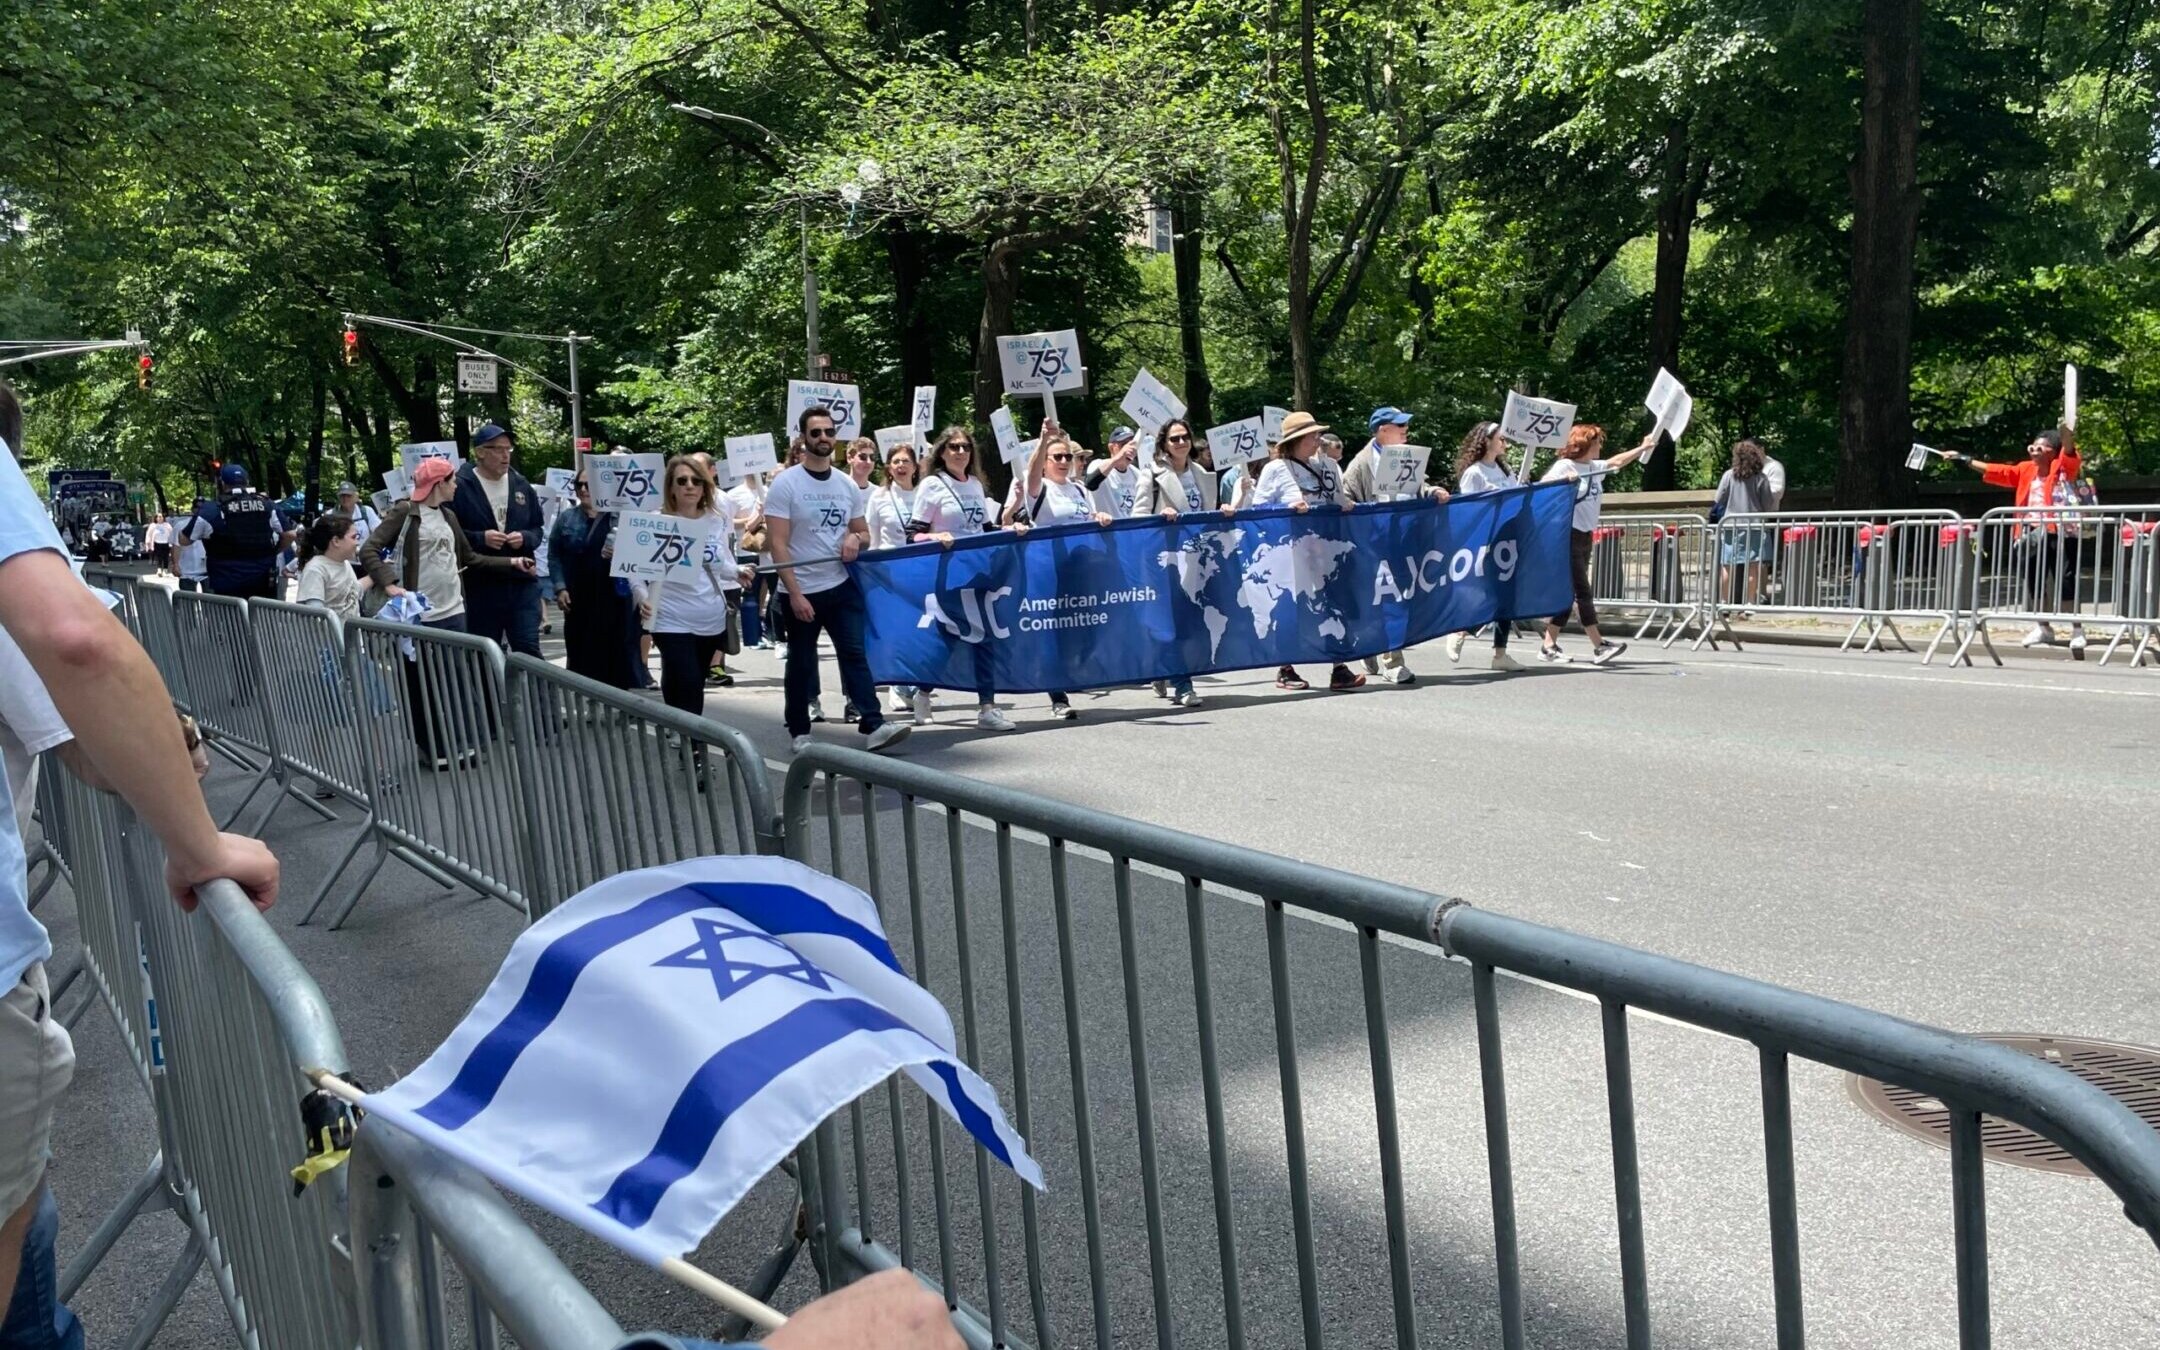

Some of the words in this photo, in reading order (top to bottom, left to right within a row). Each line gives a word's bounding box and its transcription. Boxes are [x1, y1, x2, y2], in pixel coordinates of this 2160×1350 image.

[1006, 340, 1040, 350] ISRAEL
[465, 363, 490, 371] BUSES
[1016, 351, 1027, 364] @
[1027, 349, 1061, 378] 75
[467, 371, 488, 379] ONLY
[824, 372, 828, 380] E
[797, 386, 832, 396] ISRAEL
[1010, 380, 1024, 389] AJC
[1138, 406, 1151, 418] AJC
[1524, 411, 1555, 435] 75
[1505, 427, 1516, 436] AJC
[1230, 431, 1255, 454] 75
[591, 460, 625, 469] ISRAEL
[601, 471, 614, 484] @
[613, 469, 649, 497] 75
[240, 501, 265, 512] EMS
[596, 499, 610, 508] AJC
[820, 508, 842, 527] 75
[964, 507, 984, 524] 75
[629, 518, 670, 532] ISRAEL
[636, 530, 651, 545] @
[649, 532, 684, 564] 75
[619, 562, 639, 573] AJC
[1372, 539, 1519, 606] AJC.org
[1018, 592, 1098, 613] American
[1101, 586, 1157, 606] Jewish
[917, 586, 1012, 644] AJC
[1018, 611, 1108, 632] Committee
